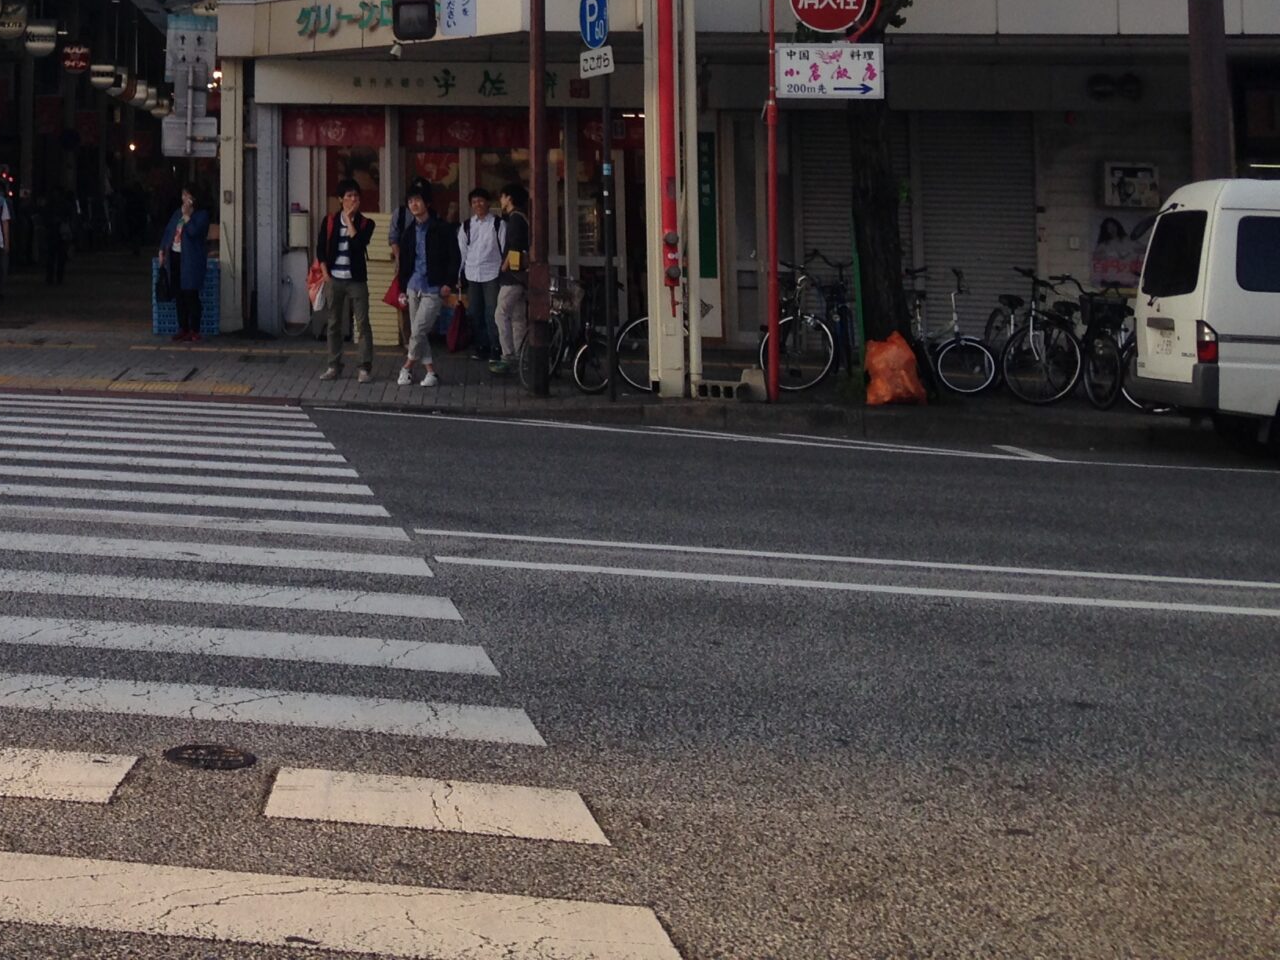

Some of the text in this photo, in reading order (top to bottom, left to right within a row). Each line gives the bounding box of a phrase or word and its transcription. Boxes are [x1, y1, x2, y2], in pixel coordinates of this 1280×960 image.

[582, 52, 610, 72] ここから
[786, 49, 874, 61] 中国 料理
[784, 62, 878, 83] 小倉飯店
[786, 84, 827, 95] 200m先
